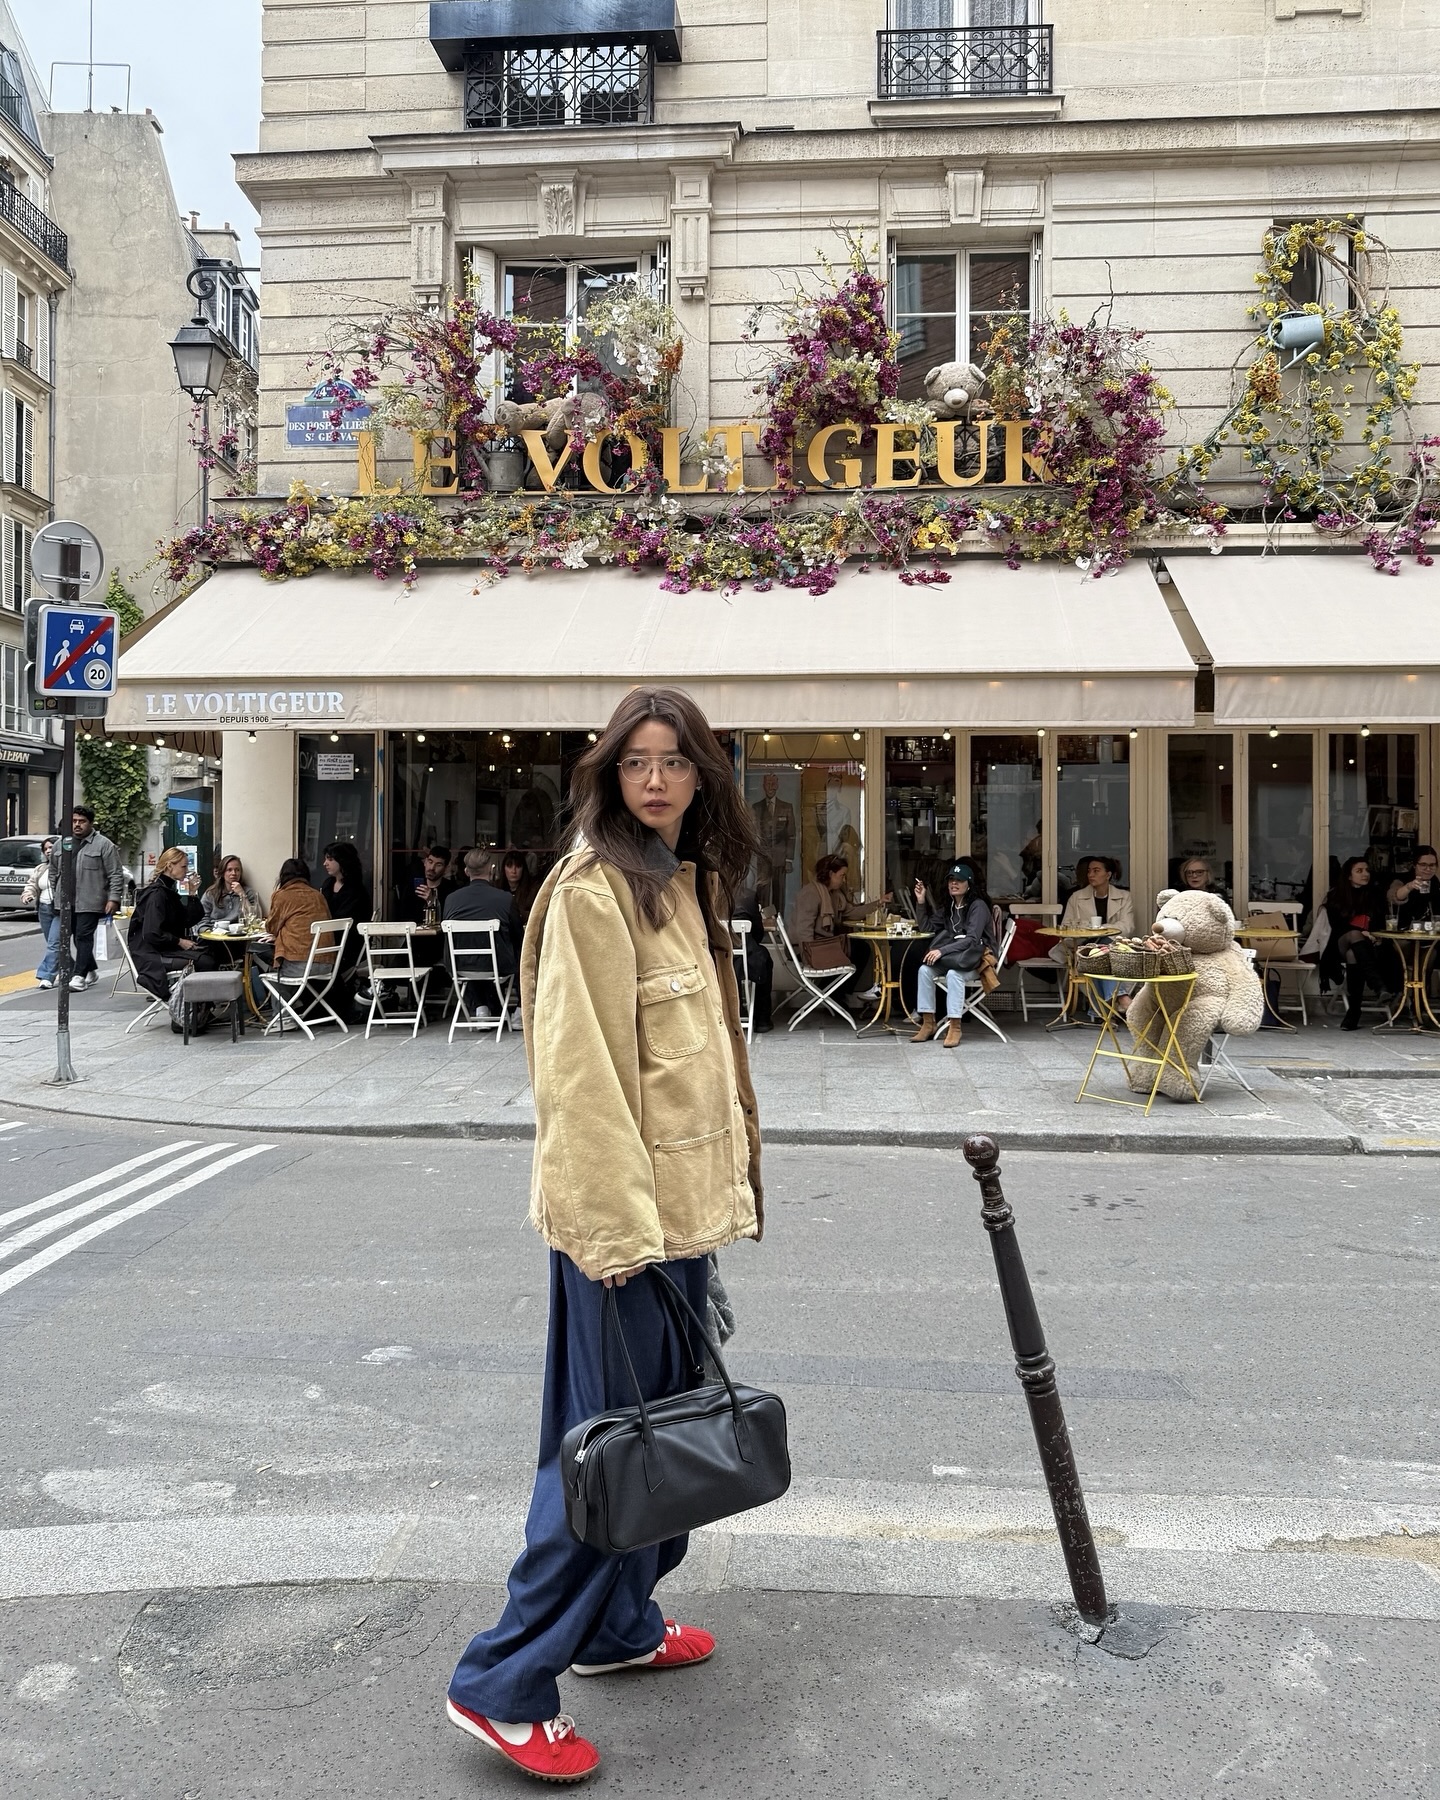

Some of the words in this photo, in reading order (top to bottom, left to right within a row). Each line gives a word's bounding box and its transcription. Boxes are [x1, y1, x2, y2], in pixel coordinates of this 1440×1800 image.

[289, 422, 305, 431] DES
[351, 429, 458, 495] LE
[90, 669, 105, 680] 20
[145, 693, 177, 715] LE
[183, 691, 346, 714] VOLTIGEUR
[219, 716, 249, 724] DEPUIS
[250, 715, 270, 723] 1906
[183, 814, 196, 832] P
